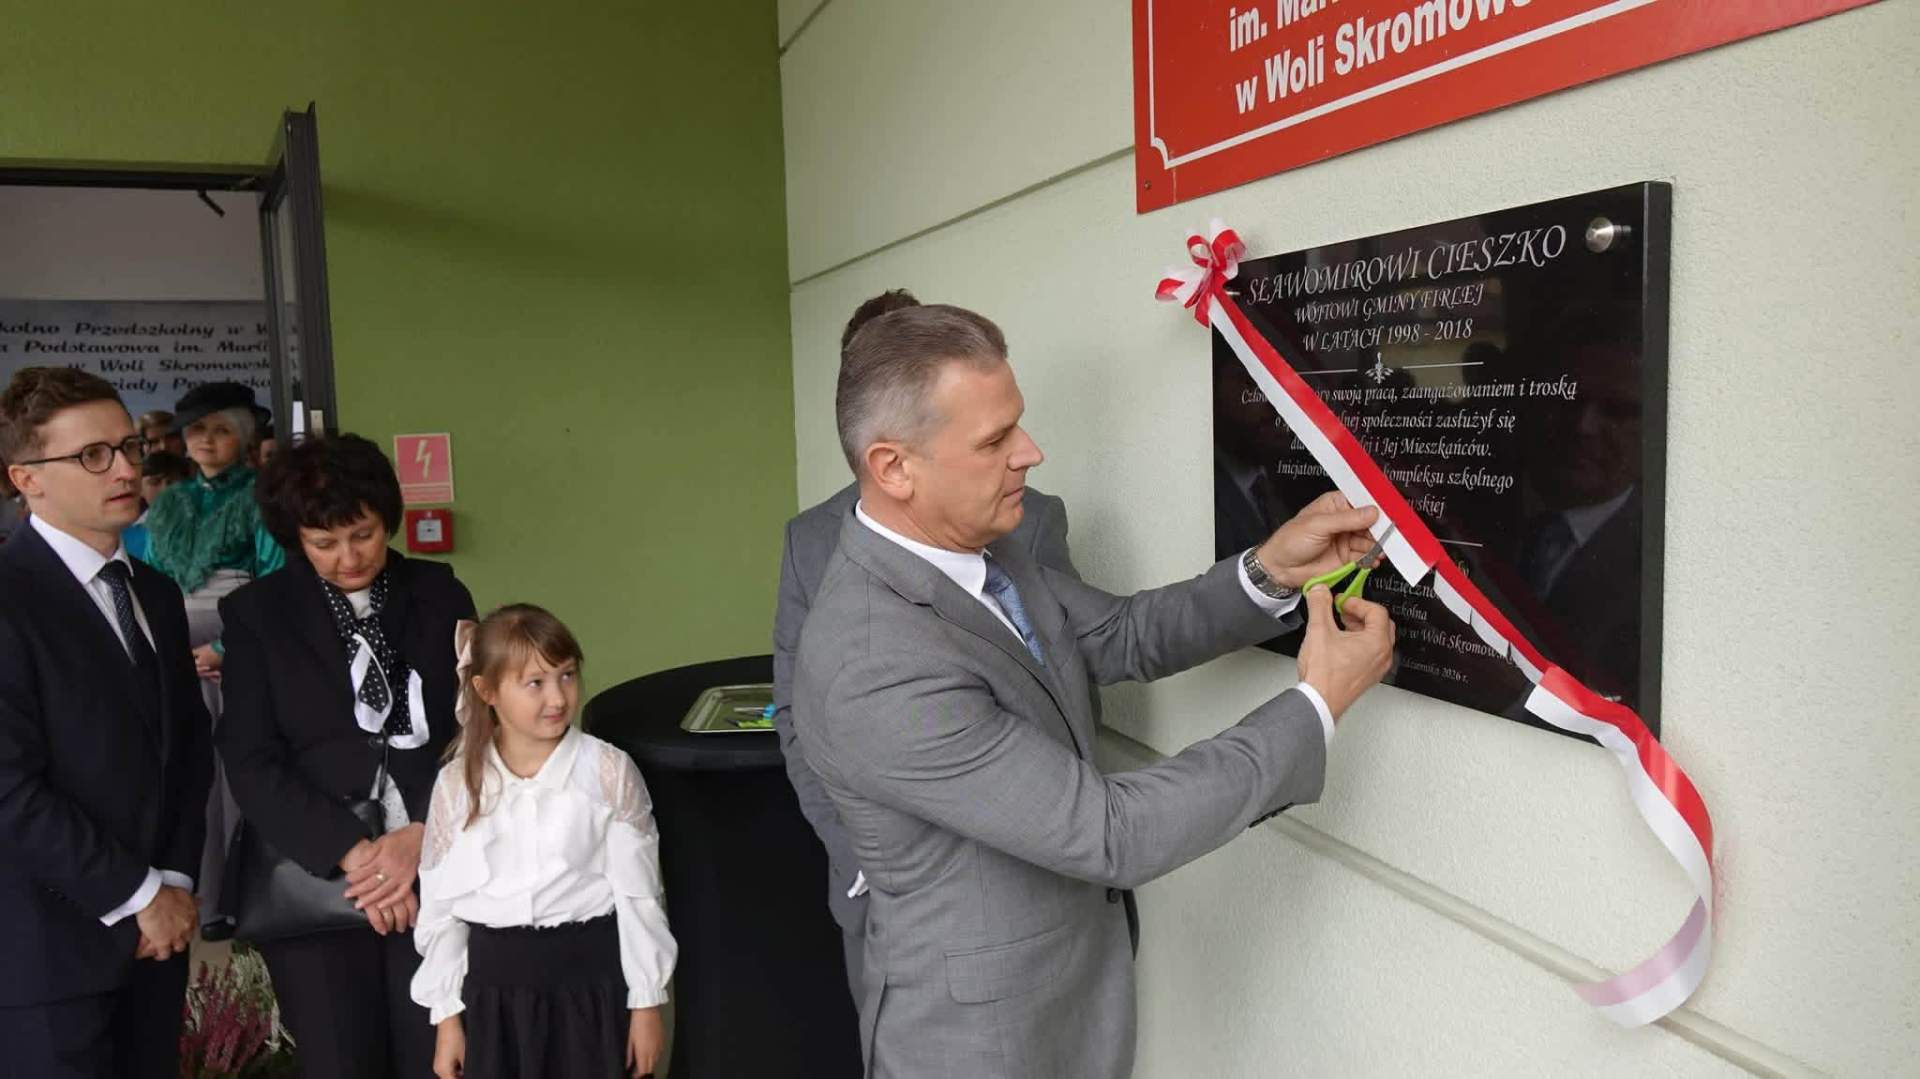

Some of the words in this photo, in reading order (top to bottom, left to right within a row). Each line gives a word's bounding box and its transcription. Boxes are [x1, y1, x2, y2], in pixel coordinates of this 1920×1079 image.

[1229, 7, 1268, 52] im.
[1235, 75, 1258, 115] w
[1264, 34, 1325, 104] Woli
[1247, 247, 1420, 306] SŁAWOMIROWI
[1427, 225, 1566, 279] CIESZKO
[1295, 297, 1360, 324] WÓJTOWI
[1363, 290, 1419, 322] GMINY
[1421, 283, 1484, 309] FIRLEJ
[75, 321, 215, 338] Przedszkolny
[1302, 331, 1319, 351] W
[1320, 325, 1385, 352] LATACH
[1388, 322, 1421, 345] 1998
[1434, 318, 1474, 341] 2018
[24, 340, 160, 354] Podstawowa
[101, 359, 145, 372] Woli
[159, 359, 270, 372] Skromowsk
[1333, 384, 1362, 406] swoją
[1364, 386, 1398, 406] pracą,
[1401, 378, 1515, 405] zaangażowaniem
[1518, 377, 1526, 397] i
[1529, 374, 1577, 400] troską
[1361, 408, 1433, 431] społeczności
[1435, 409, 1496, 434] zasłużył
[1496, 410, 1516, 432] się
[1401, 436, 1492, 459] Mieszkańców.
[1447, 466, 1514, 495] szkolnego
